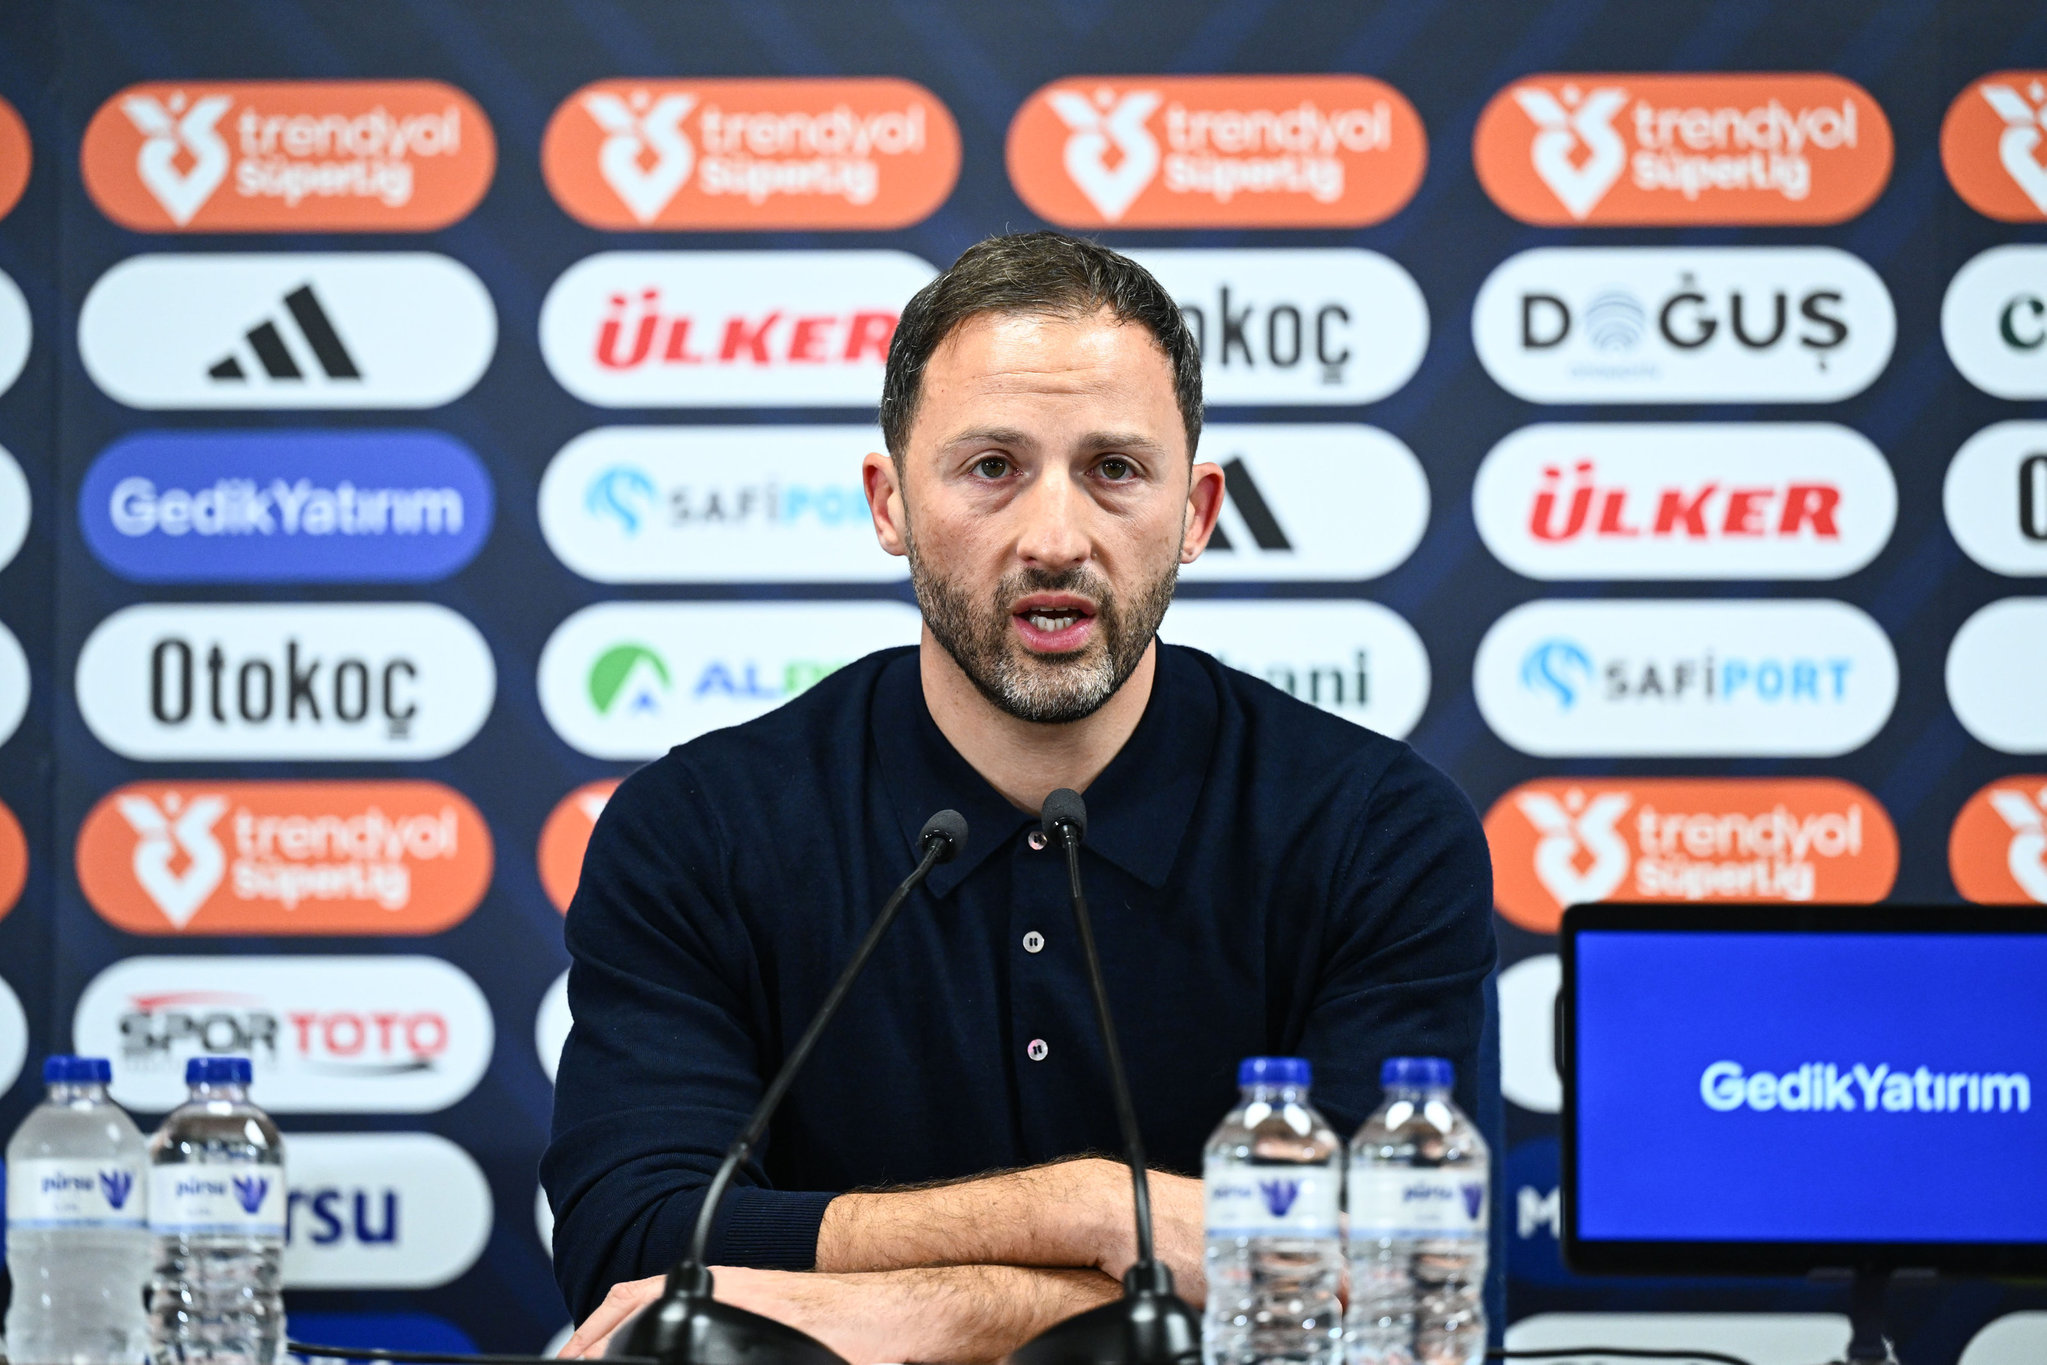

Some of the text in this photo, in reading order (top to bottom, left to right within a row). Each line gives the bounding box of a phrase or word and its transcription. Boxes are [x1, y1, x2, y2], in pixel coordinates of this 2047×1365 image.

[239, 105, 460, 162] trendyol
[702, 104, 925, 161] trendyol
[1166, 101, 1391, 159] trendyol
[1634, 99, 1857, 156] trendyol
[596, 289, 900, 368] ÜLKER
[1529, 461, 1841, 543] ÜLKER
[150, 636, 417, 739] Otokoç
[234, 807, 457, 865] trendyol
[1636, 804, 1862, 862] trendyol
[119, 1010, 448, 1056] SPOR TOTO
[1700, 1060, 2031, 1112] GedikYatırım
